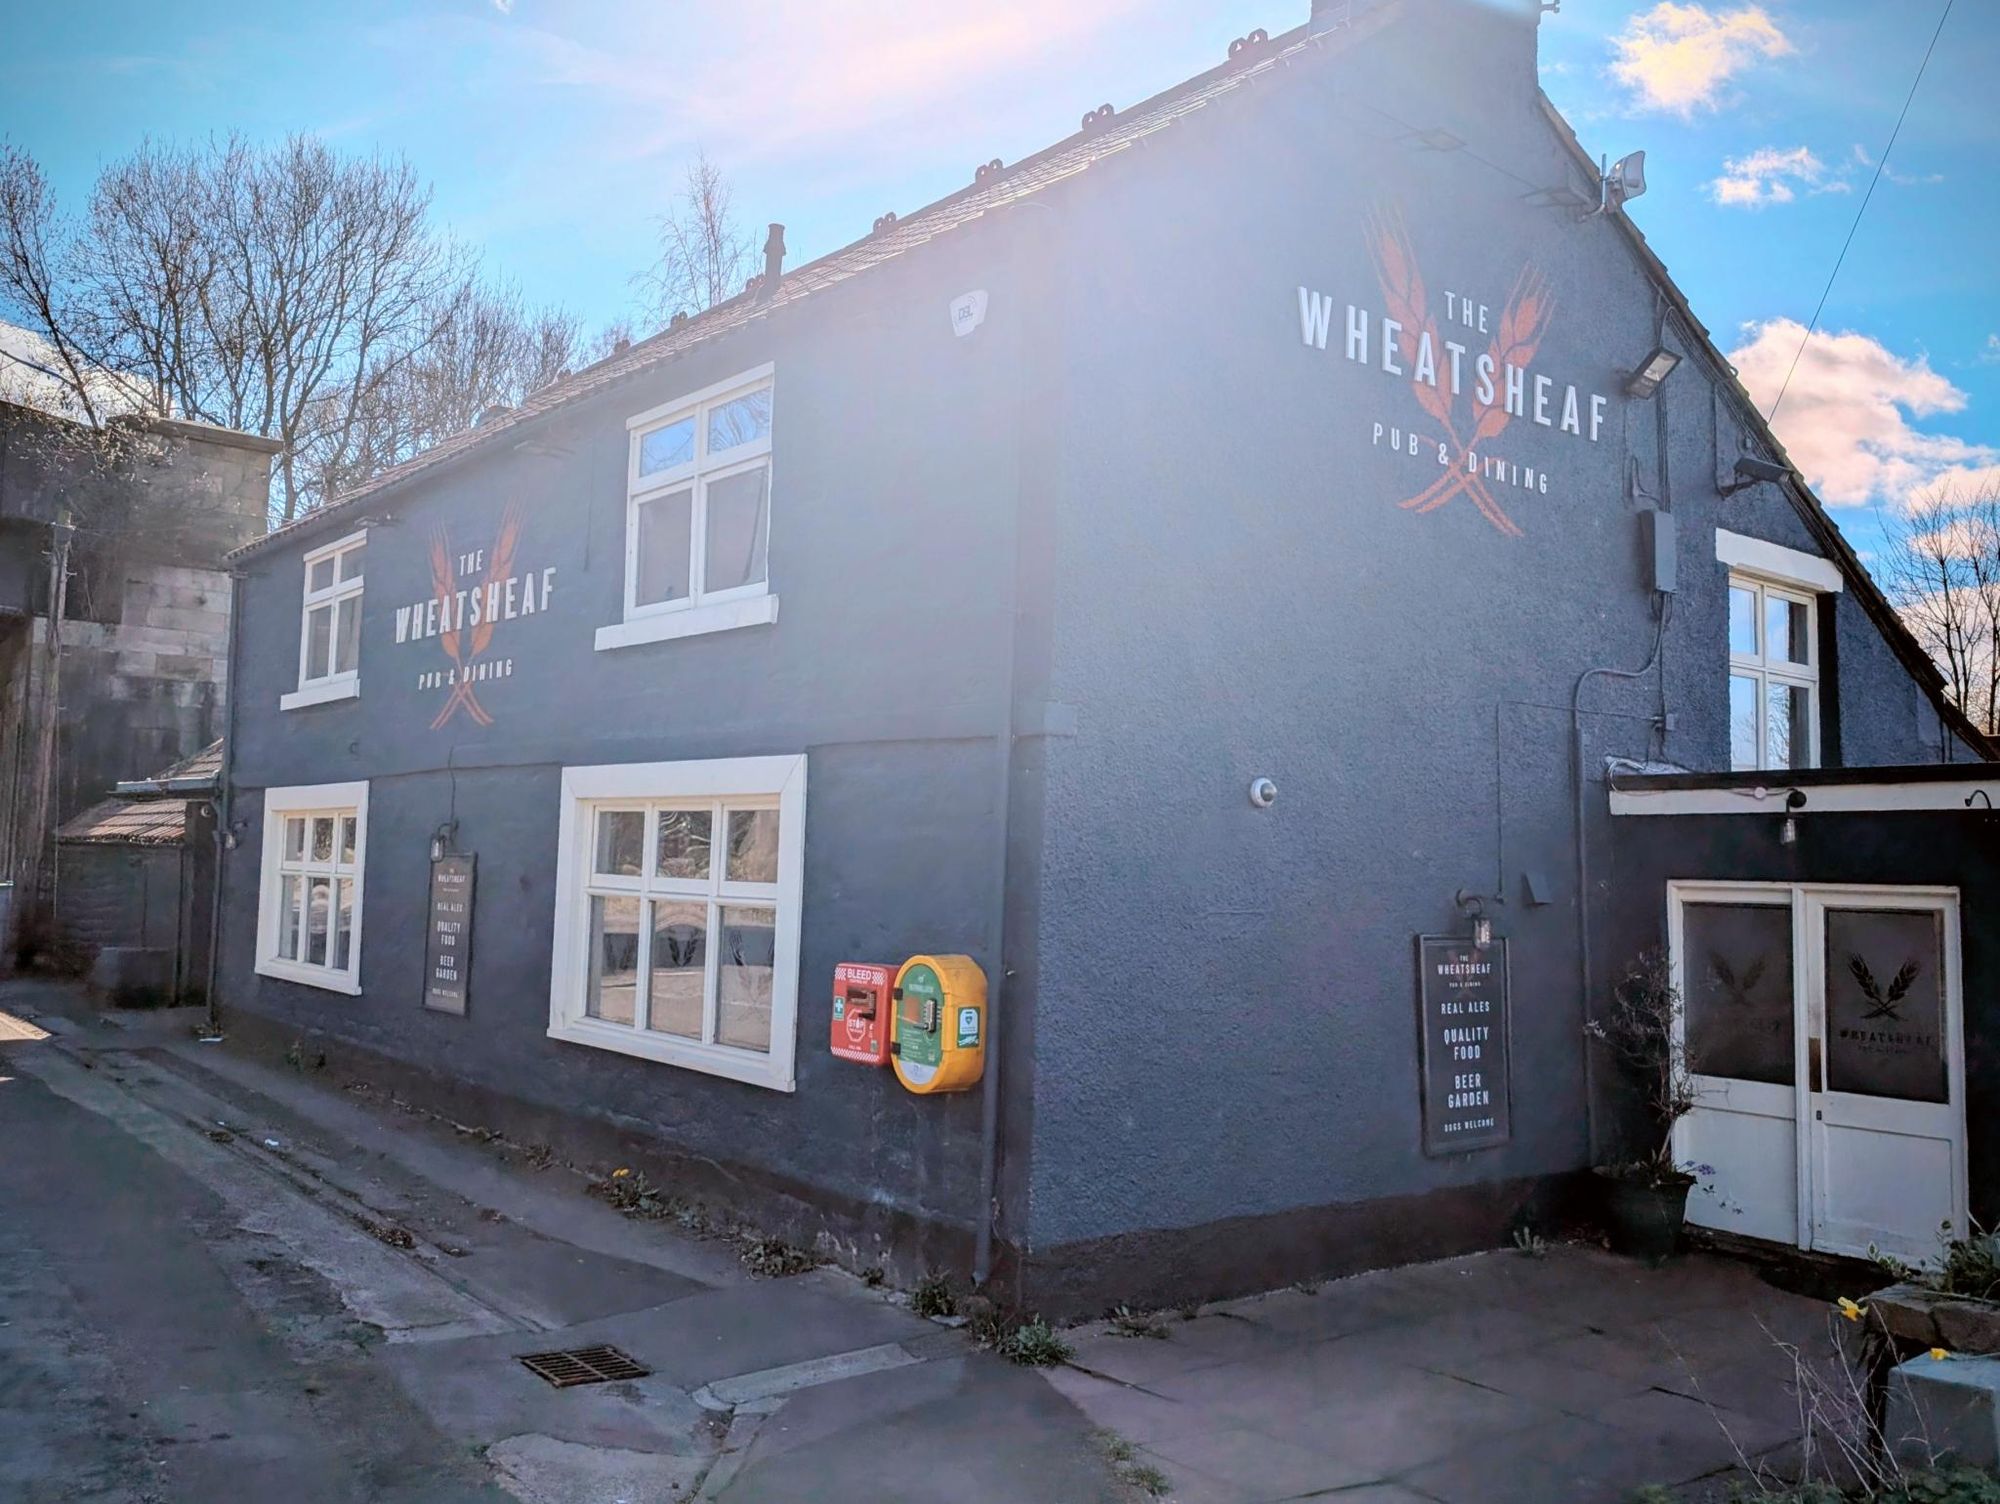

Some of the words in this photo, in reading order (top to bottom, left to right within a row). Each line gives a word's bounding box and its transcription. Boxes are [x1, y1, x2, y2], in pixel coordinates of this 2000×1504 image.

[1444, 290, 1489, 334] THE
[1297, 286, 1607, 442] WHEATSHEAF
[1373, 422, 1418, 456] PUB
[1438, 443, 1449, 466] &
[1468, 451, 1548, 494] DINING
[459, 549, 483, 576] THE
[395, 567, 557, 644] WHEATSHEAF
[418, 671, 441, 690] PUB
[448, 669, 455, 685] &
[463, 658, 513, 683] DINING
[847, 968, 872, 981] BLEED
[1437, 963, 1491, 975] WHEATSHEAF
[1441, 1002, 1464, 1015] REAL
[1468, 1000, 1490, 1013] ALES
[1443, 1026, 1489, 1045] QUALITY
[1454, 1045, 1481, 1061] FOOD
[1454, 1072, 1481, 1090] BEER
[1448, 1090, 1489, 1109] GARDEN
[1464, 1117, 1495, 1130] WELCOME
